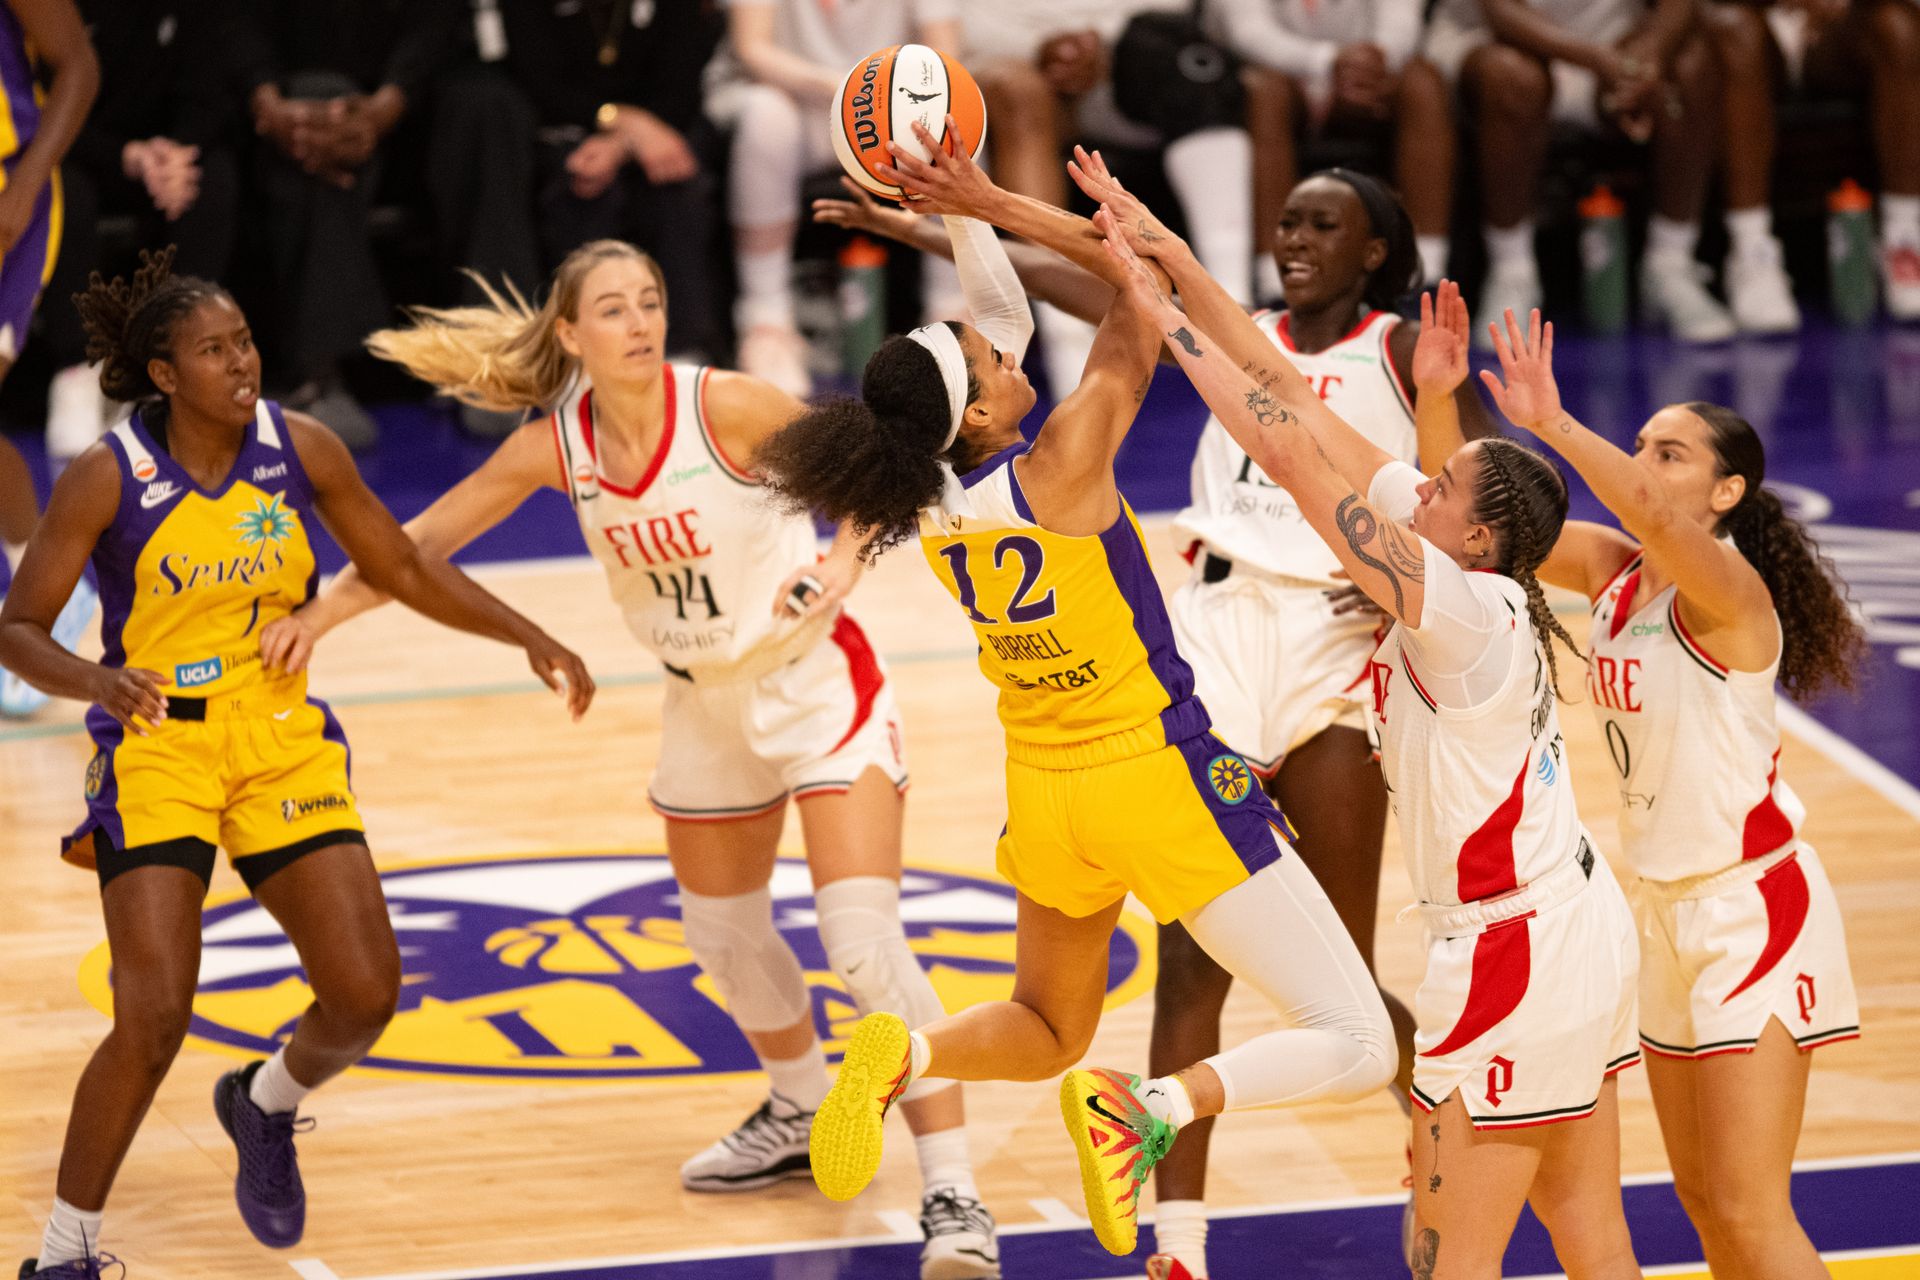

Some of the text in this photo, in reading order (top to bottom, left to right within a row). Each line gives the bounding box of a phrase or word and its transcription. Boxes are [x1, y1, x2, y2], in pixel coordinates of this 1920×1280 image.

[852, 55, 885, 152] Wilson
[253, 461, 287, 481] Albert
[666, 463, 711, 486] chime
[146, 480, 173, 498] NIKE
[603, 508, 712, 568] FIRE
[645, 566, 722, 620] 44
[939, 535, 1056, 625] 12
[652, 621, 735, 650] LASHIFY
[986, 628, 1073, 661] BURRELL
[181, 663, 217, 684] UCLA
[1606, 719, 1630, 779] 0
[298, 796, 348, 814] WNBA
